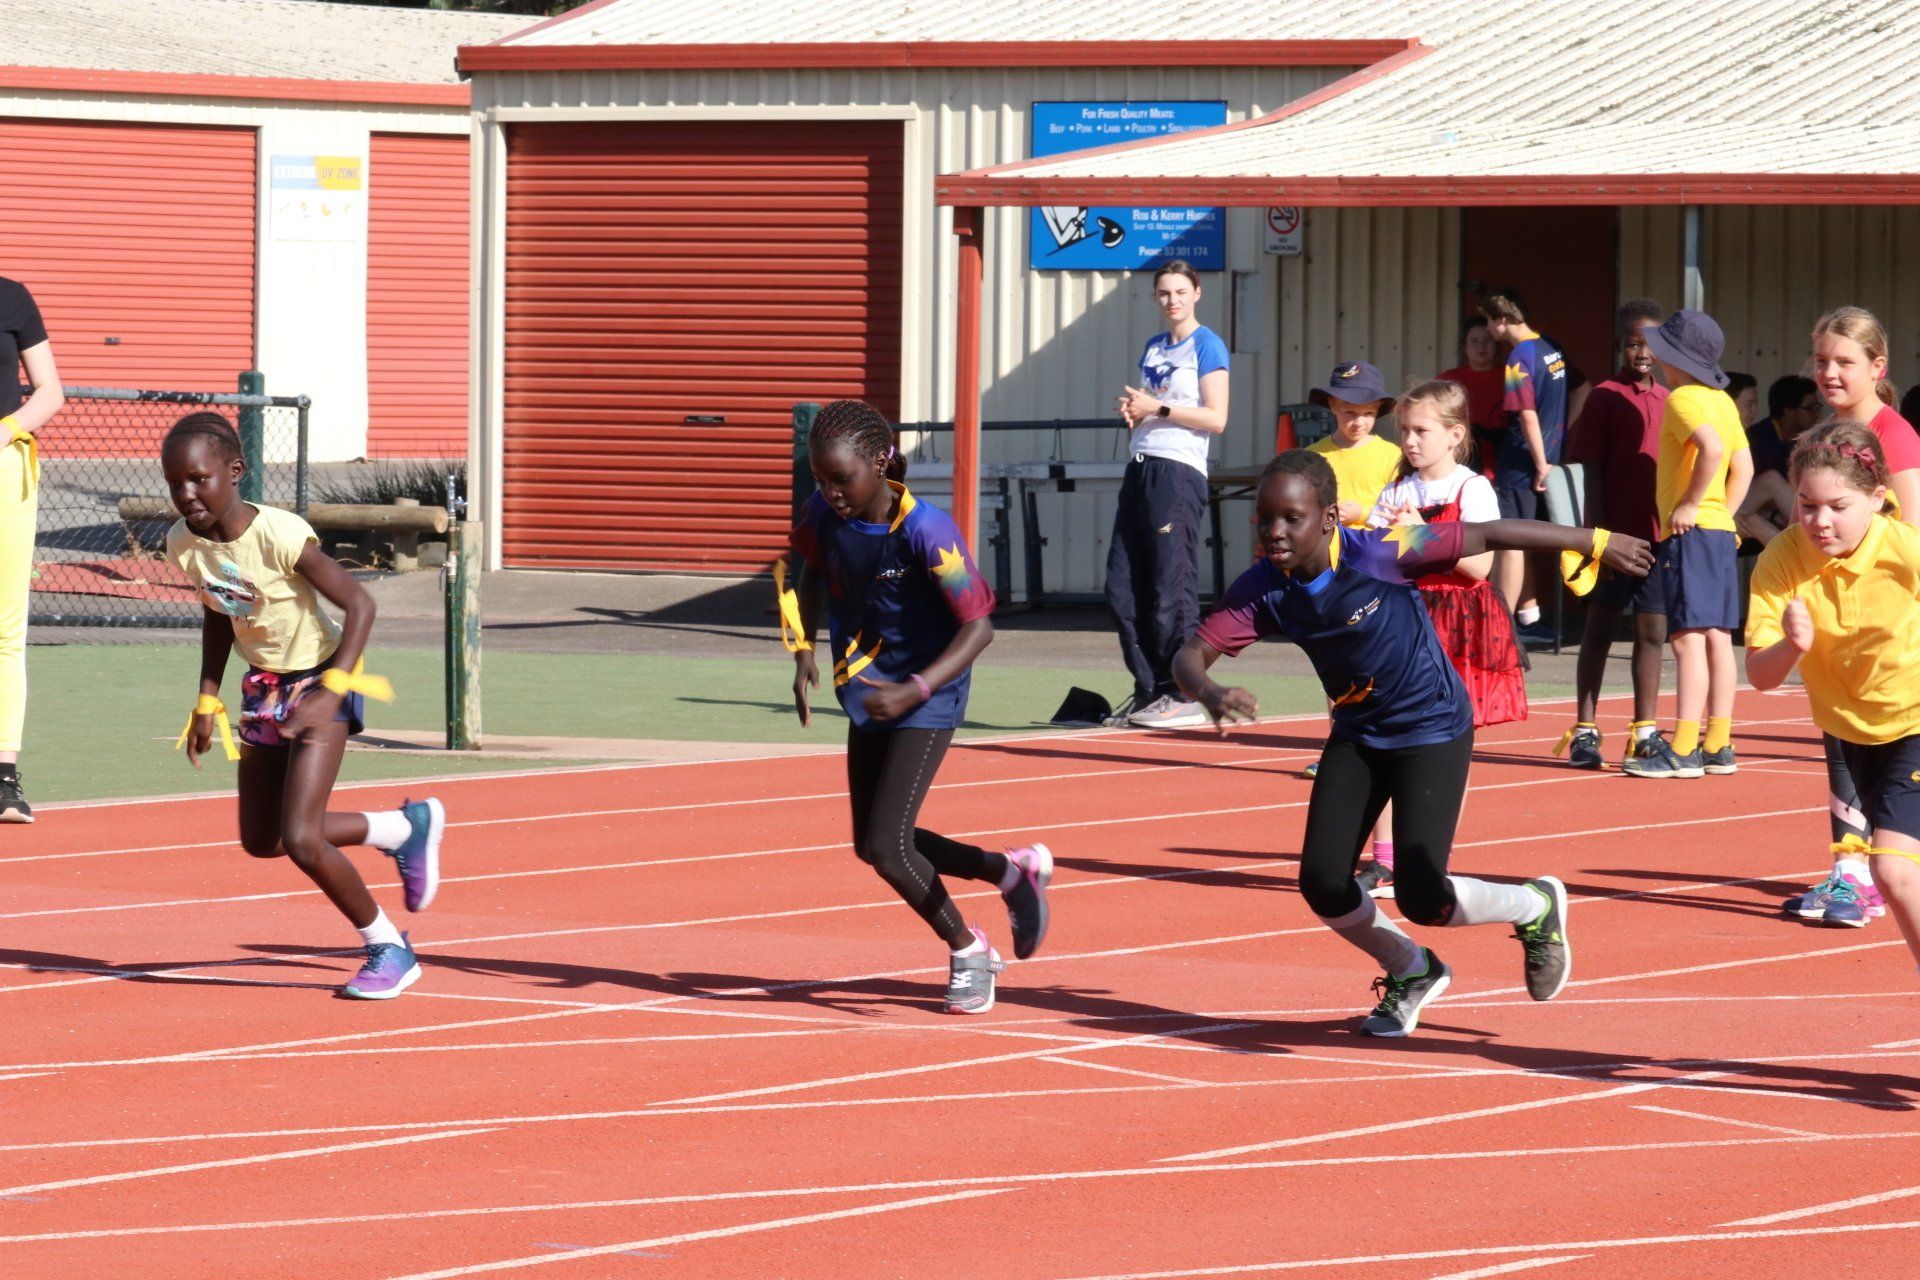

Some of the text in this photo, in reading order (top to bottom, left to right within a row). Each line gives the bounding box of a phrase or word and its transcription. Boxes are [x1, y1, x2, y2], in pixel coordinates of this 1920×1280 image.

[1082, 108, 1096, 119] FOR
[1098, 108, 1119, 119] FRESH
[1121, 108, 1148, 119] QUALITY
[1050, 124, 1065, 133] BEEF
